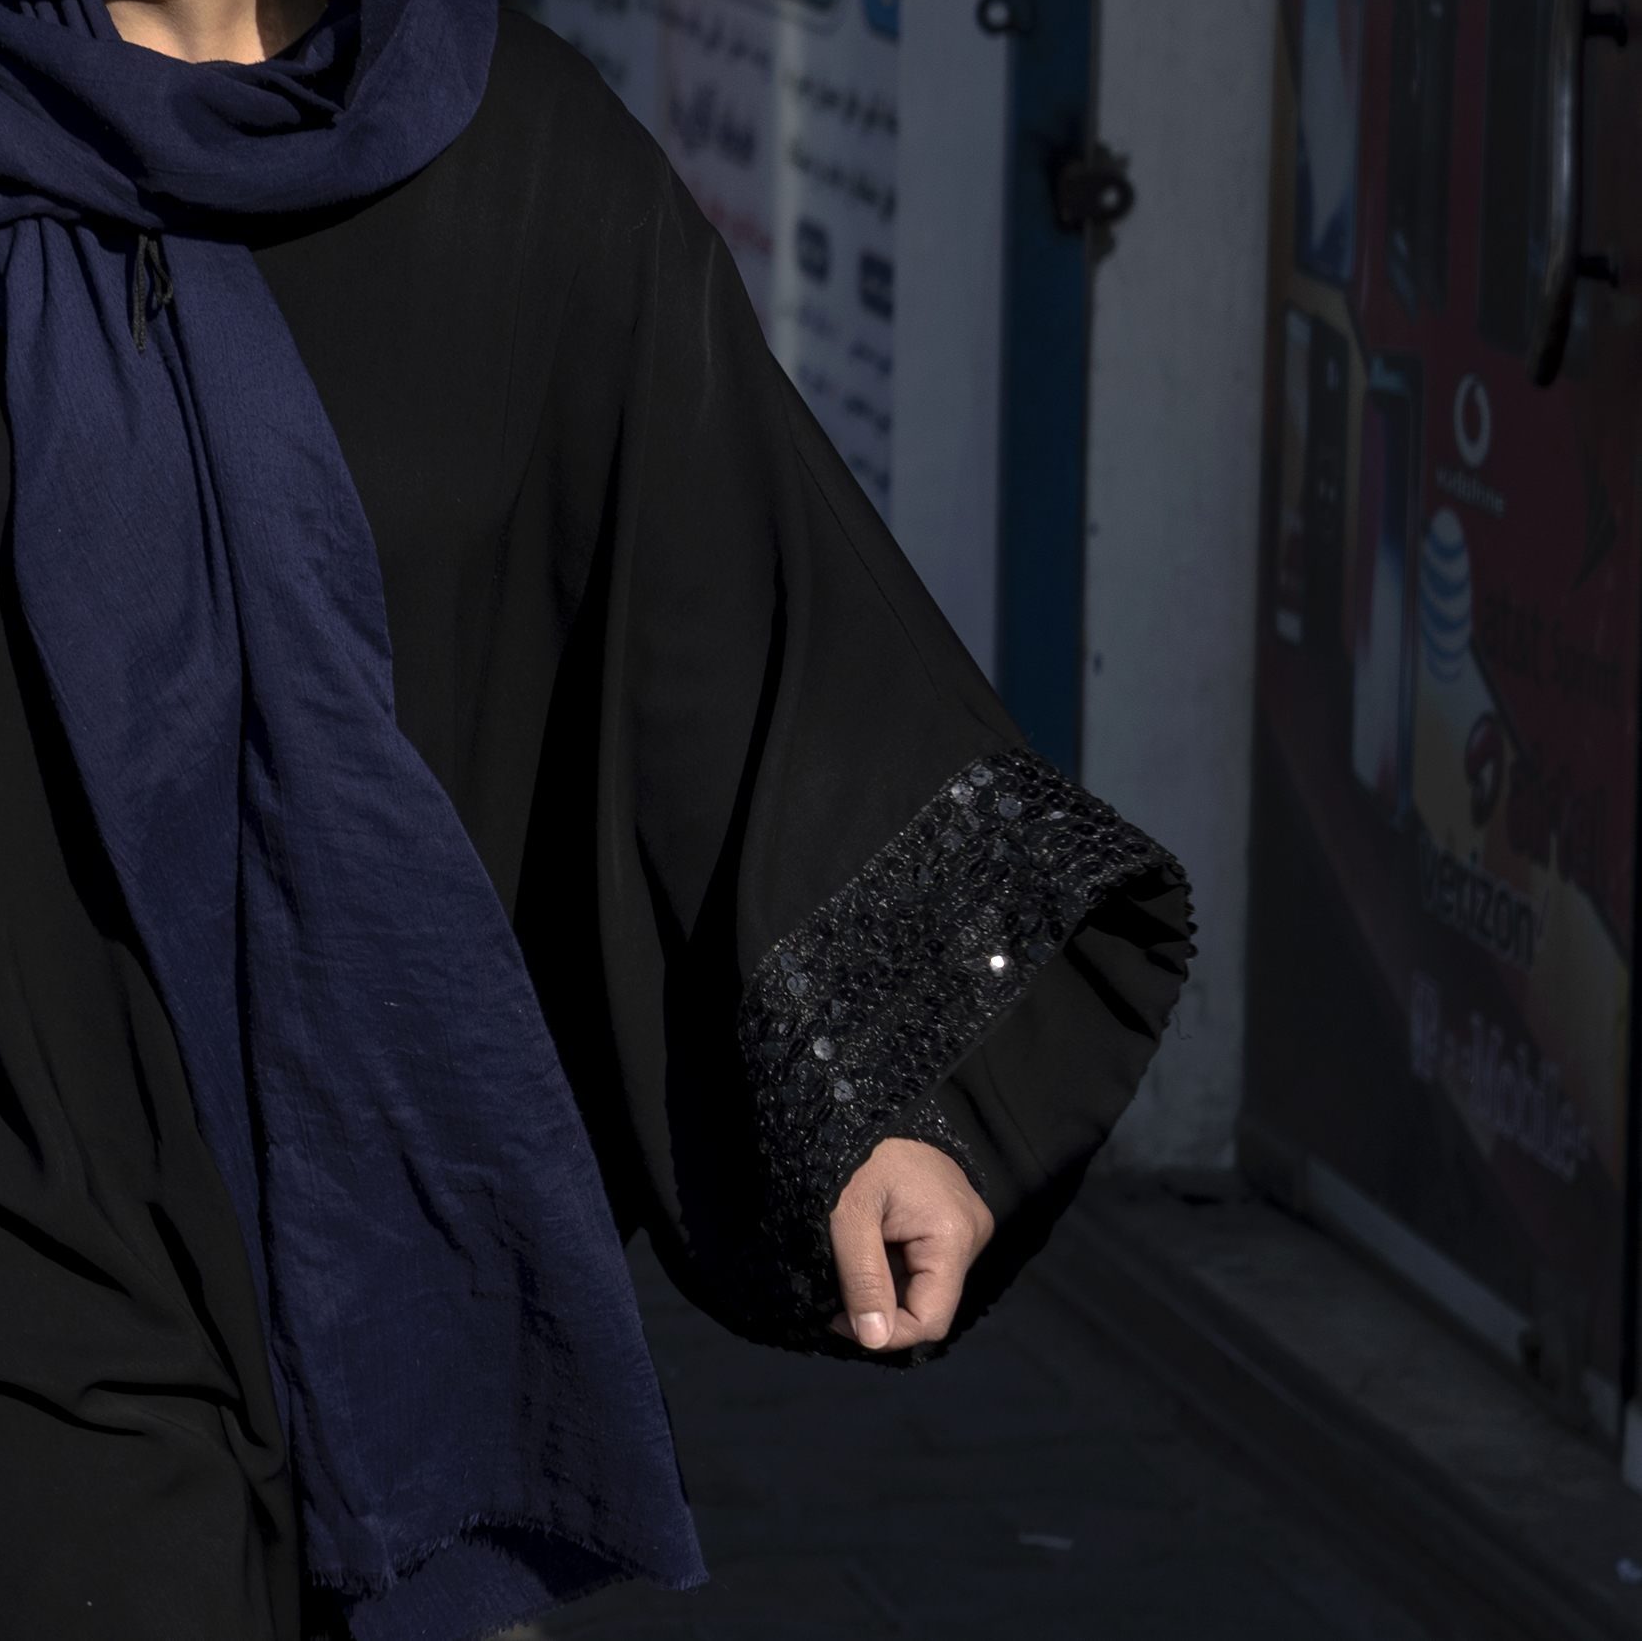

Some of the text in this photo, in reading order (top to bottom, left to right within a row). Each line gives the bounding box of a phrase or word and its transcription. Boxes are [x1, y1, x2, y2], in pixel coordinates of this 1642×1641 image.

[1436, 463, 1507, 518] vodafone
[1550, 619, 1623, 718] Sprint
[1505, 740, 1608, 898] airtel
[1418, 840, 1535, 968] verizon
